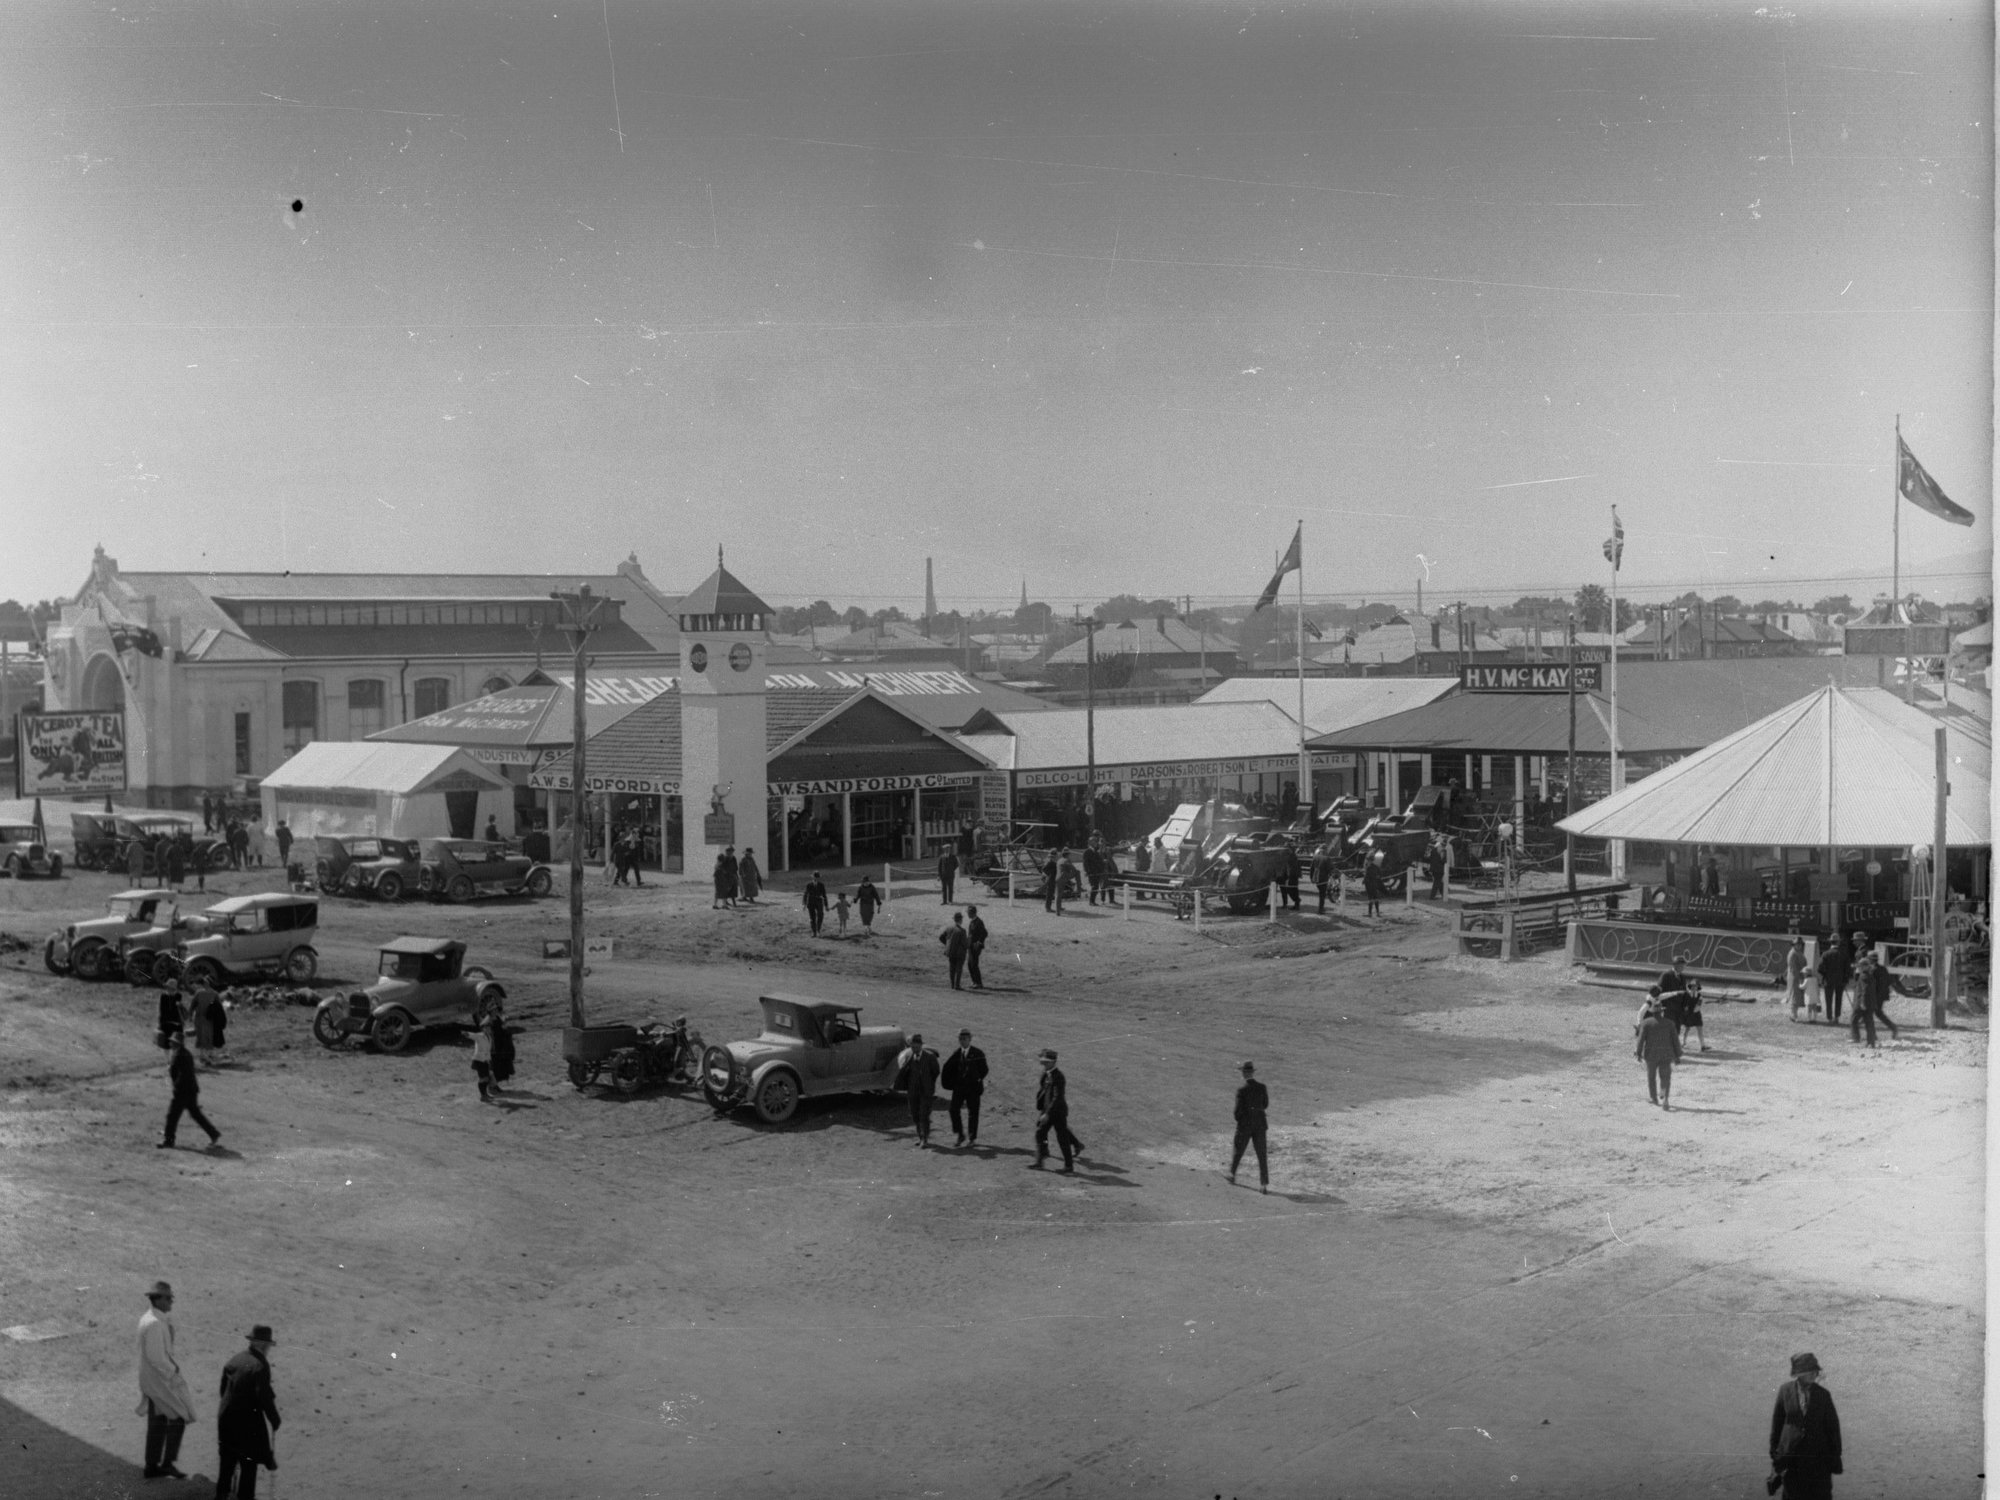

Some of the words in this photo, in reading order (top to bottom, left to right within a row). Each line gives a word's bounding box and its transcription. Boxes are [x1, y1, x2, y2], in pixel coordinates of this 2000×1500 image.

[1574, 667, 1597, 678] PTY
[825, 671, 981, 696] MACHINERY
[24, 716, 84, 747] VICEROY
[89, 714, 122, 742] TEA
[30, 744, 62, 762] ONLY
[96, 738, 116, 749] ALL
[1130, 764, 1183, 780] PARSONS
[1187, 761, 1245, 776] ROBERTSON
[1267, 755, 1350, 768] FRIGAIRE
[530, 775, 556, 788] A.W.
[653, 782, 660, 793] &
[767, 782, 796, 797] A.W.
[796, 775, 911, 795] SANDFORD
[913, 777, 922, 788] &
